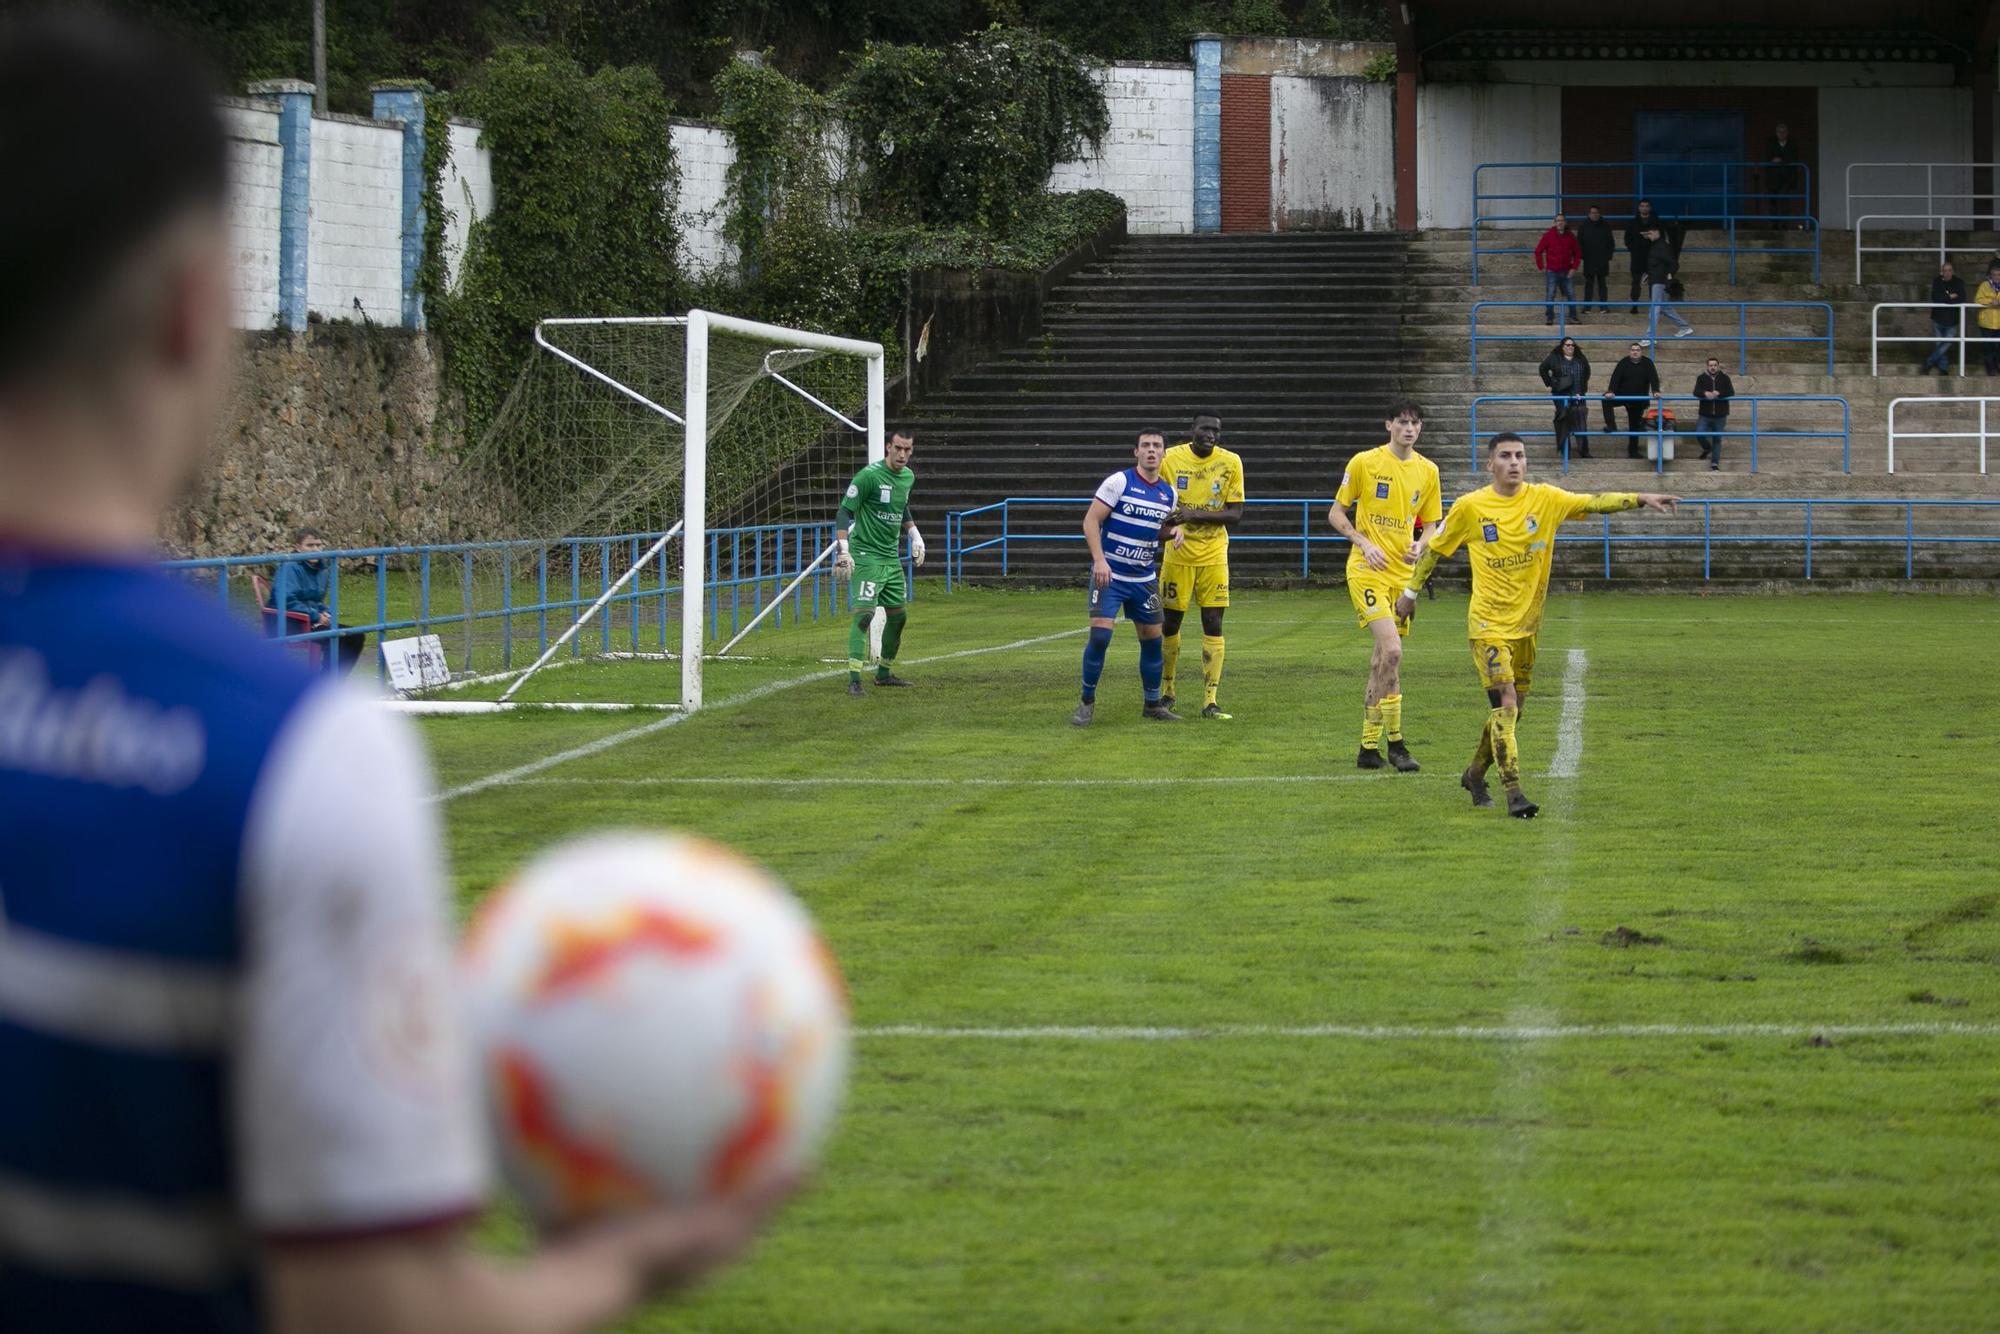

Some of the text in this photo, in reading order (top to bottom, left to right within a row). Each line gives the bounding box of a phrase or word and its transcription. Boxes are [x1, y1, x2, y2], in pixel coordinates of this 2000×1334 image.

[1486, 551, 1533, 568] tarsius
[860, 581, 876, 597] 13
[1092, 590, 1099, 604] 9
[1163, 581, 1177, 599] 15
[1364, 588, 1376, 607] 6
[1486, 646, 1501, 668] 2
